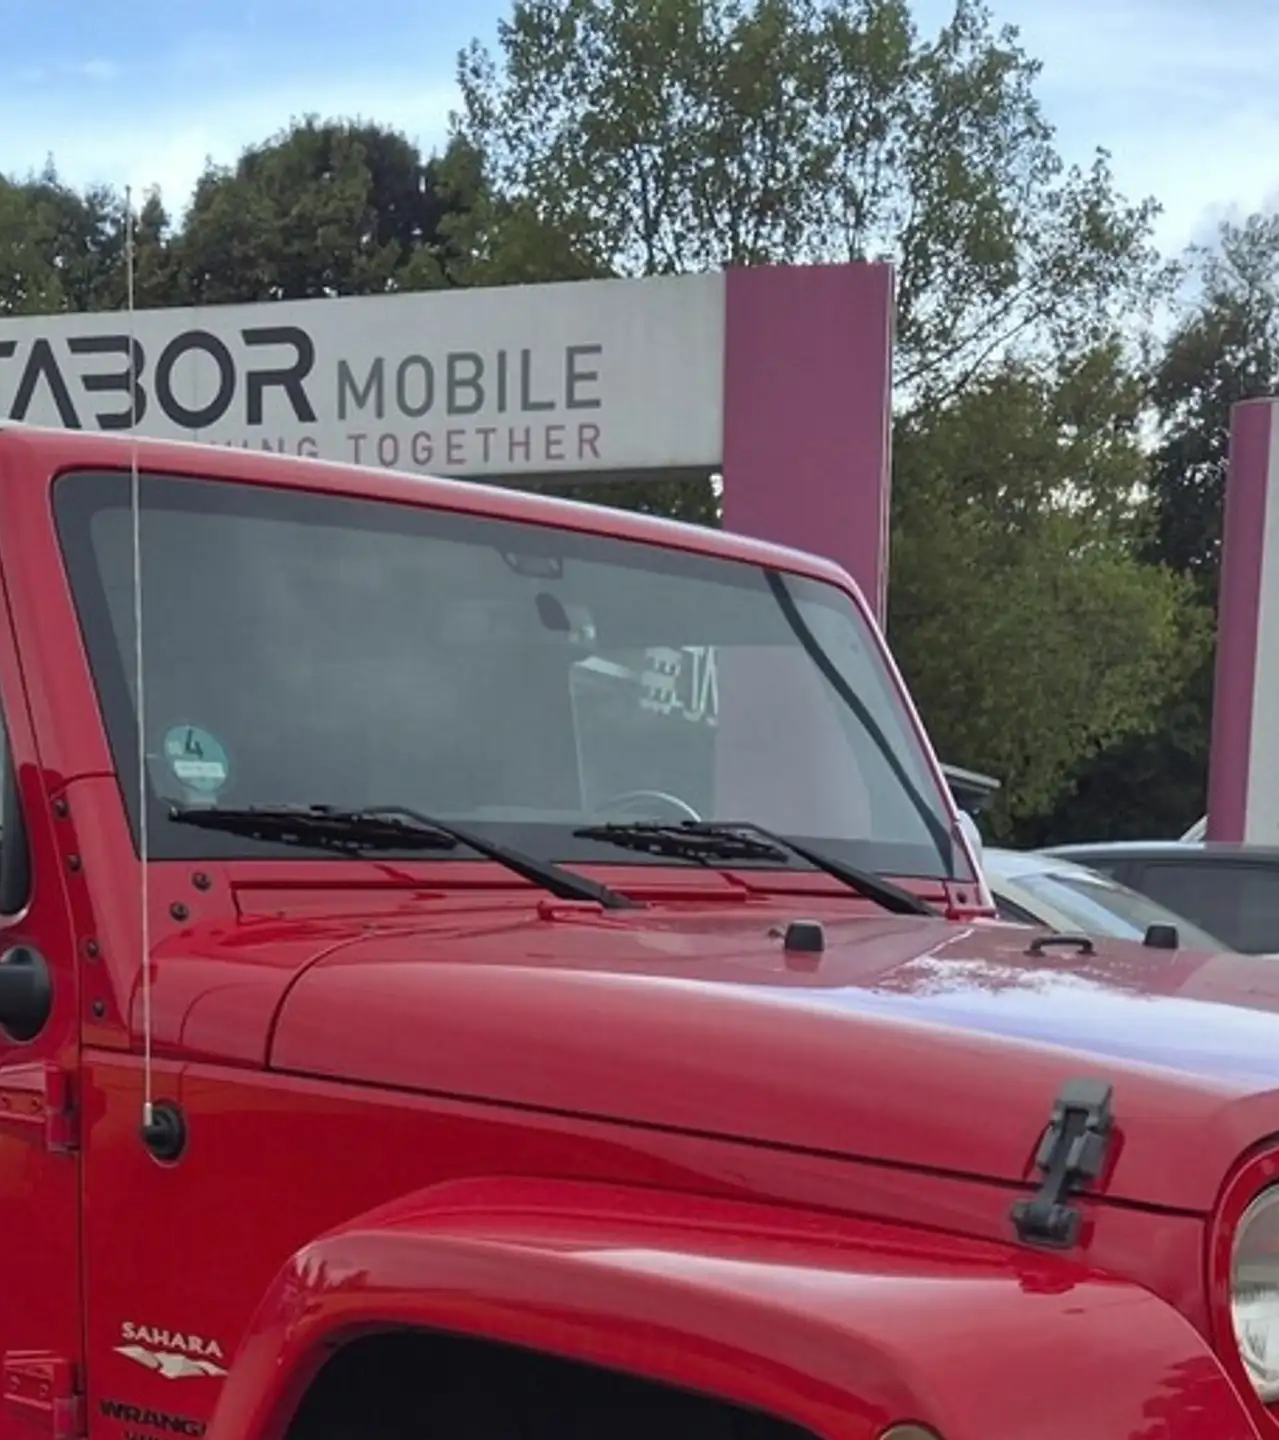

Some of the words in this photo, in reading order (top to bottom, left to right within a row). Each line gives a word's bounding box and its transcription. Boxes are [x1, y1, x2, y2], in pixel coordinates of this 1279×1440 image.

[337, 342, 604, 421] MOBILE
[347, 423, 603, 468] TOGETHER
[184, 728, 204, 759] 4
[121, 1320, 224, 1359] SAHARA
